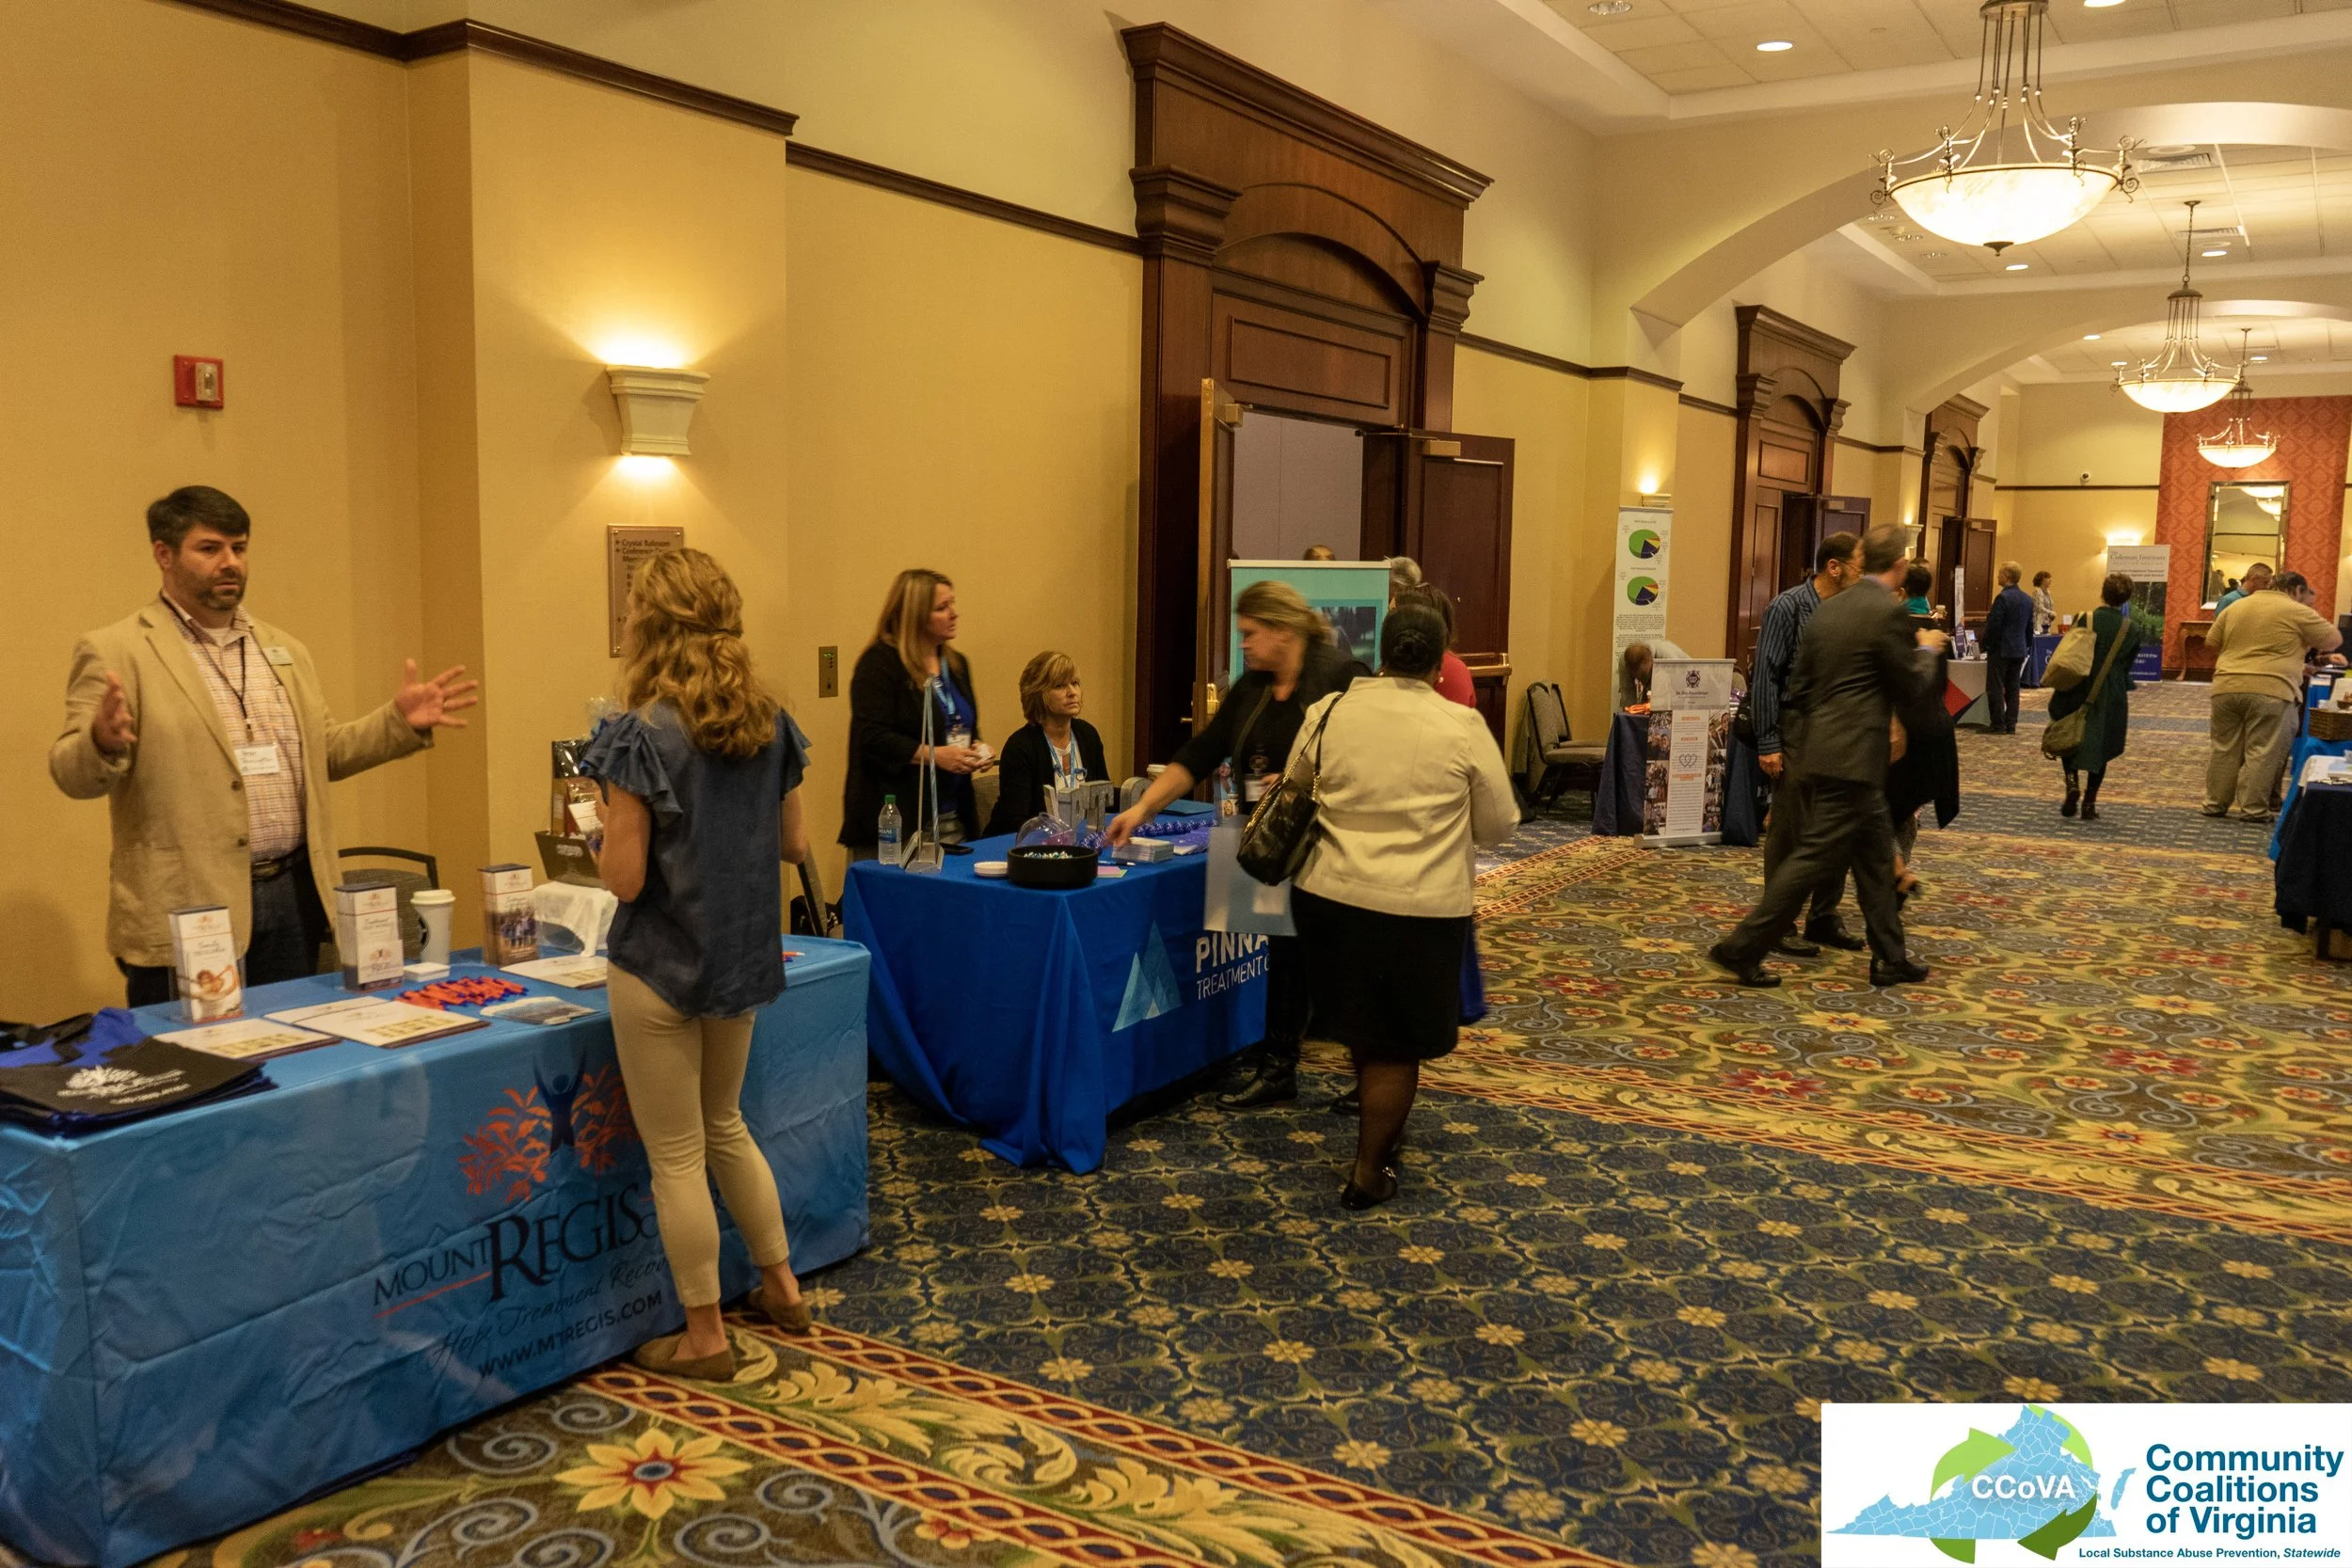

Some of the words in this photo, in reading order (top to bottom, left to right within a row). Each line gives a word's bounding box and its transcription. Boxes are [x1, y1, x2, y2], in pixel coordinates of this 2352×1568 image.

[1196, 932, 1269, 974] PINNA
[1196, 956, 1263, 1001] TREATMENT
[373, 1236, 493, 1307] MOUNT
[484, 1181, 643, 1303] REGIS
[610, 1256, 668, 1290] Recov
